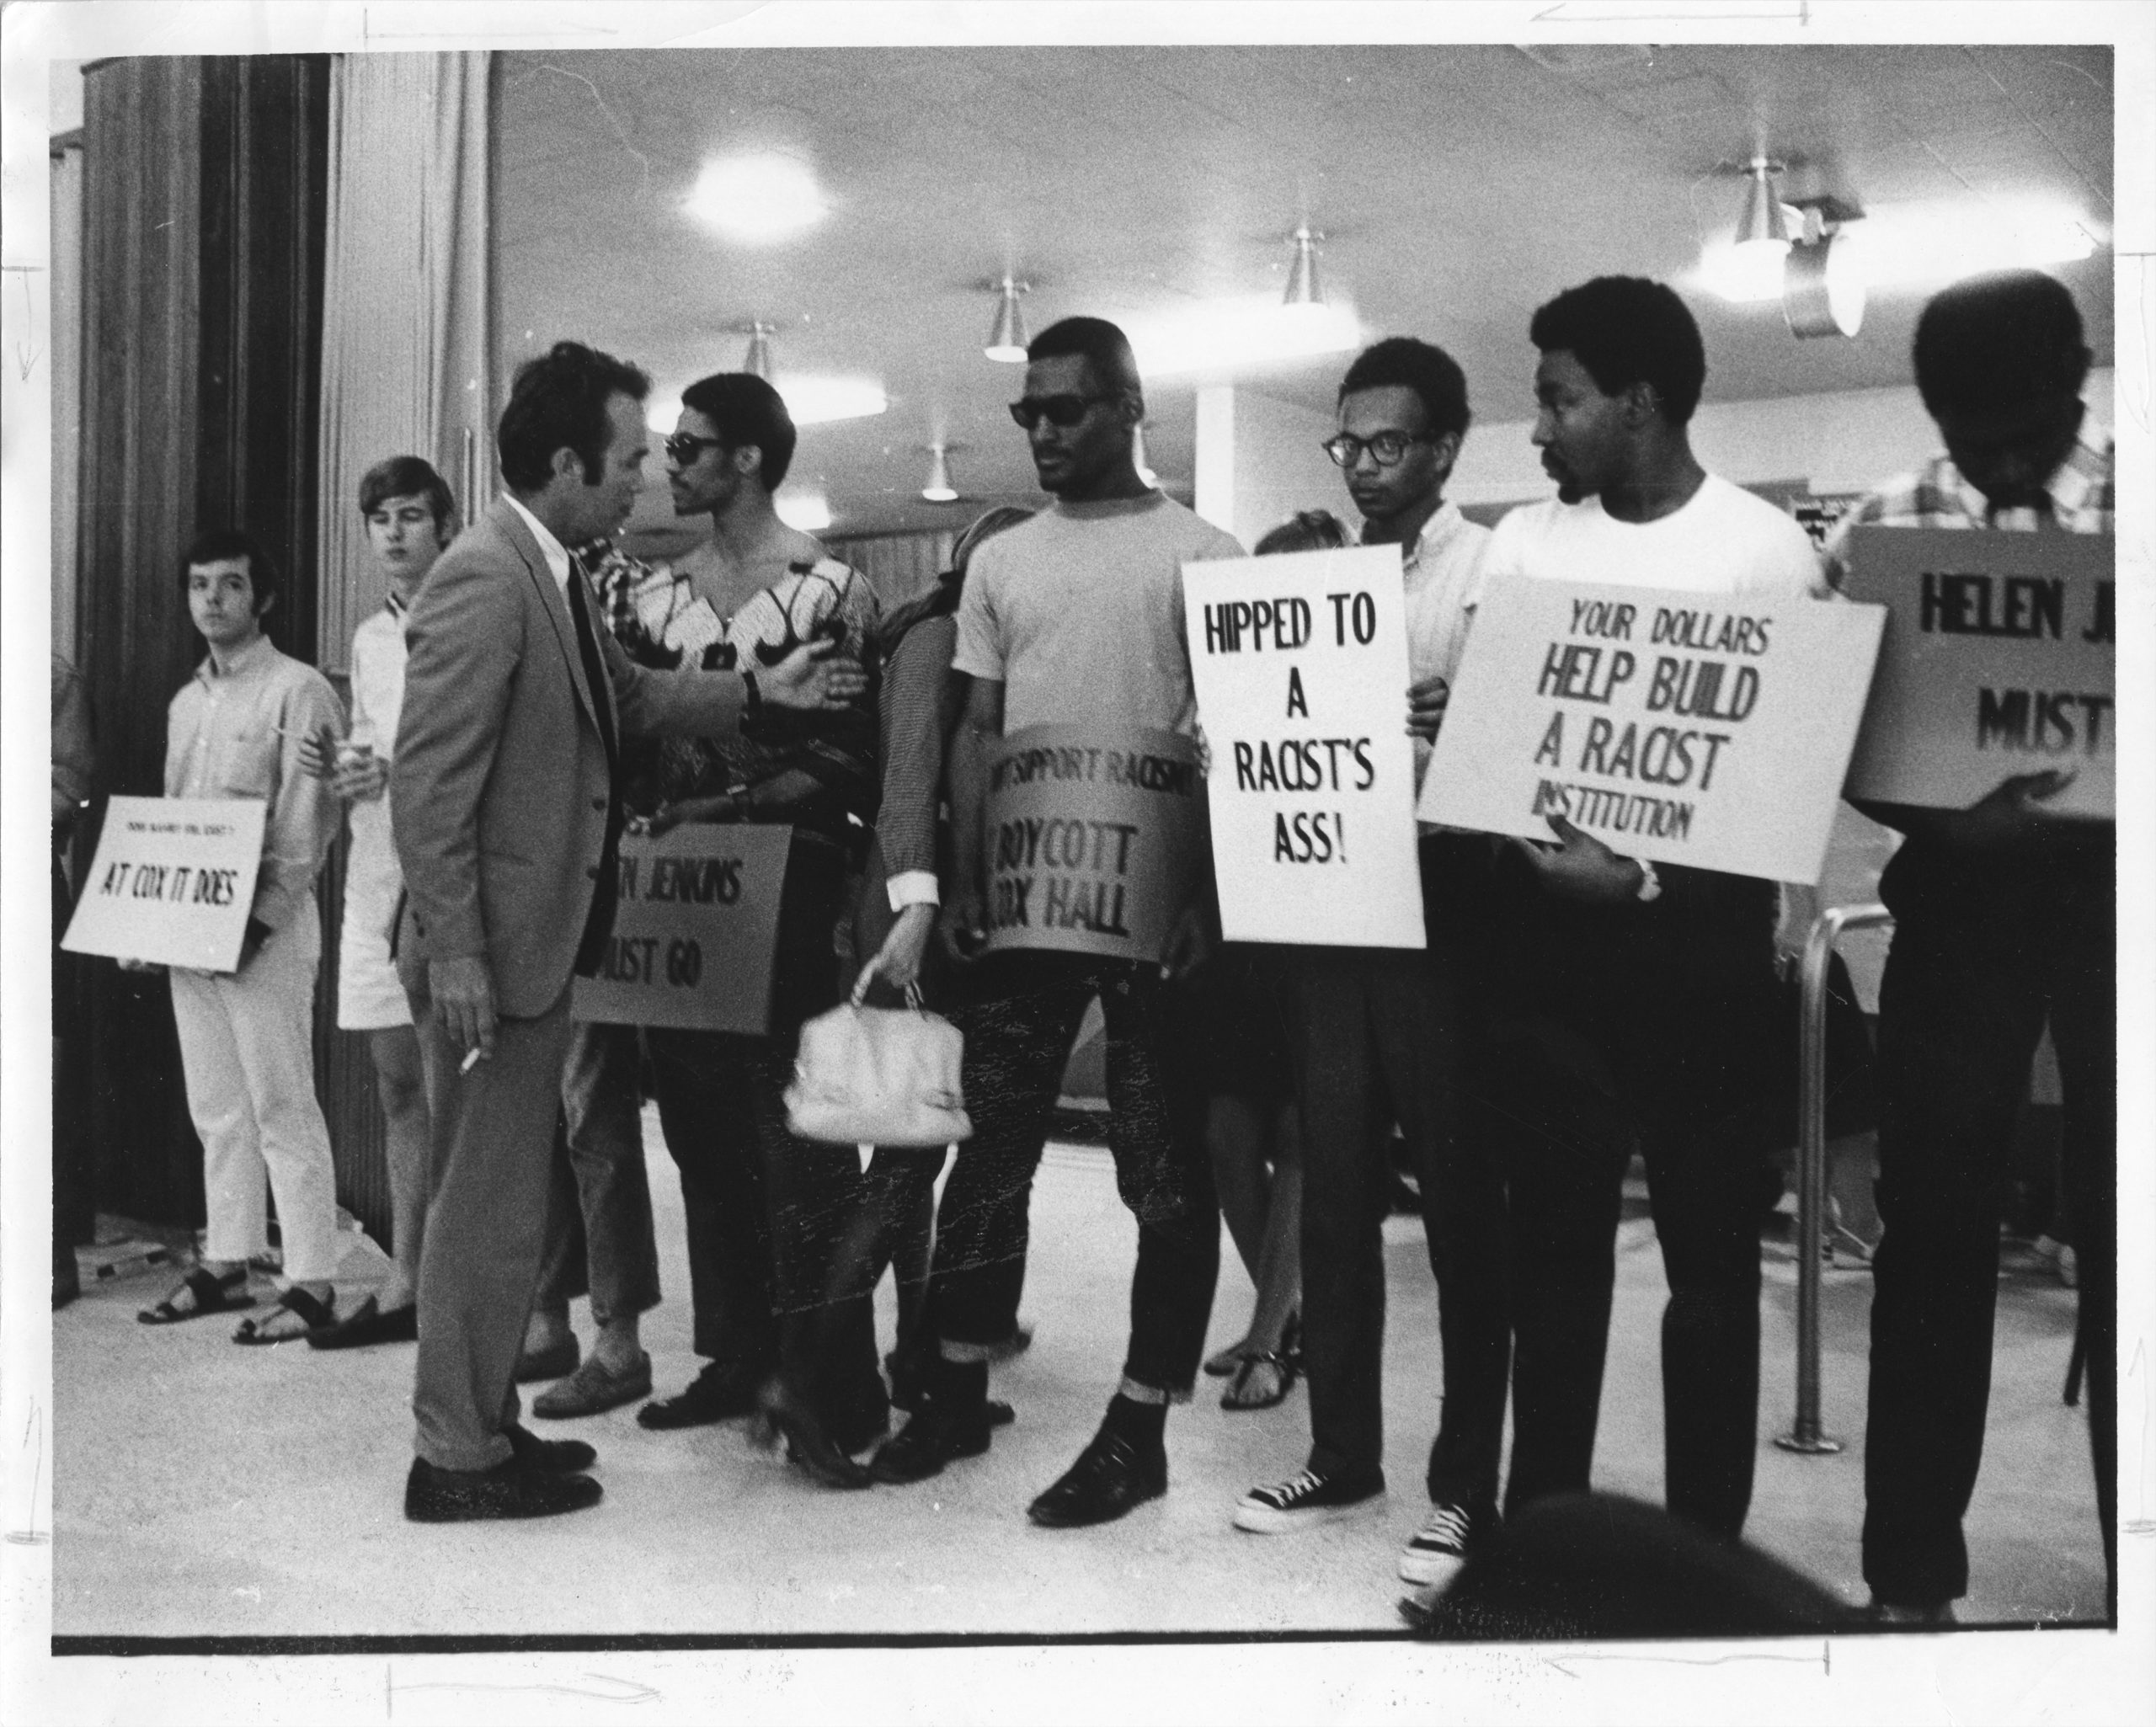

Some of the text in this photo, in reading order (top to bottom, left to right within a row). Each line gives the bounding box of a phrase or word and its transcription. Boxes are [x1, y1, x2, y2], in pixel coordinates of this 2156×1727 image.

[1204, 591, 1376, 653] HIPPED TO
[1571, 599, 1773, 656] YOUR DOLLARS
[1921, 573, 2063, 640] HELEN
[1287, 666, 1309, 719] A
[1537, 642, 1760, 722] HELP BUILD
[1978, 686, 2113, 756] MUST
[1234, 738, 1374, 792] RACIST'S
[1534, 711, 1732, 792] A RACIST
[1274, 813, 1346, 864] ASS!
[1532, 780, 1695, 840] INSTITUTION
[997, 817, 1139, 875] BOYCOTT
[99, 861, 238, 906] AT COX IT DOES
[1044, 878, 1130, 937] HALL
[601, 936, 702, 989] UST GO
